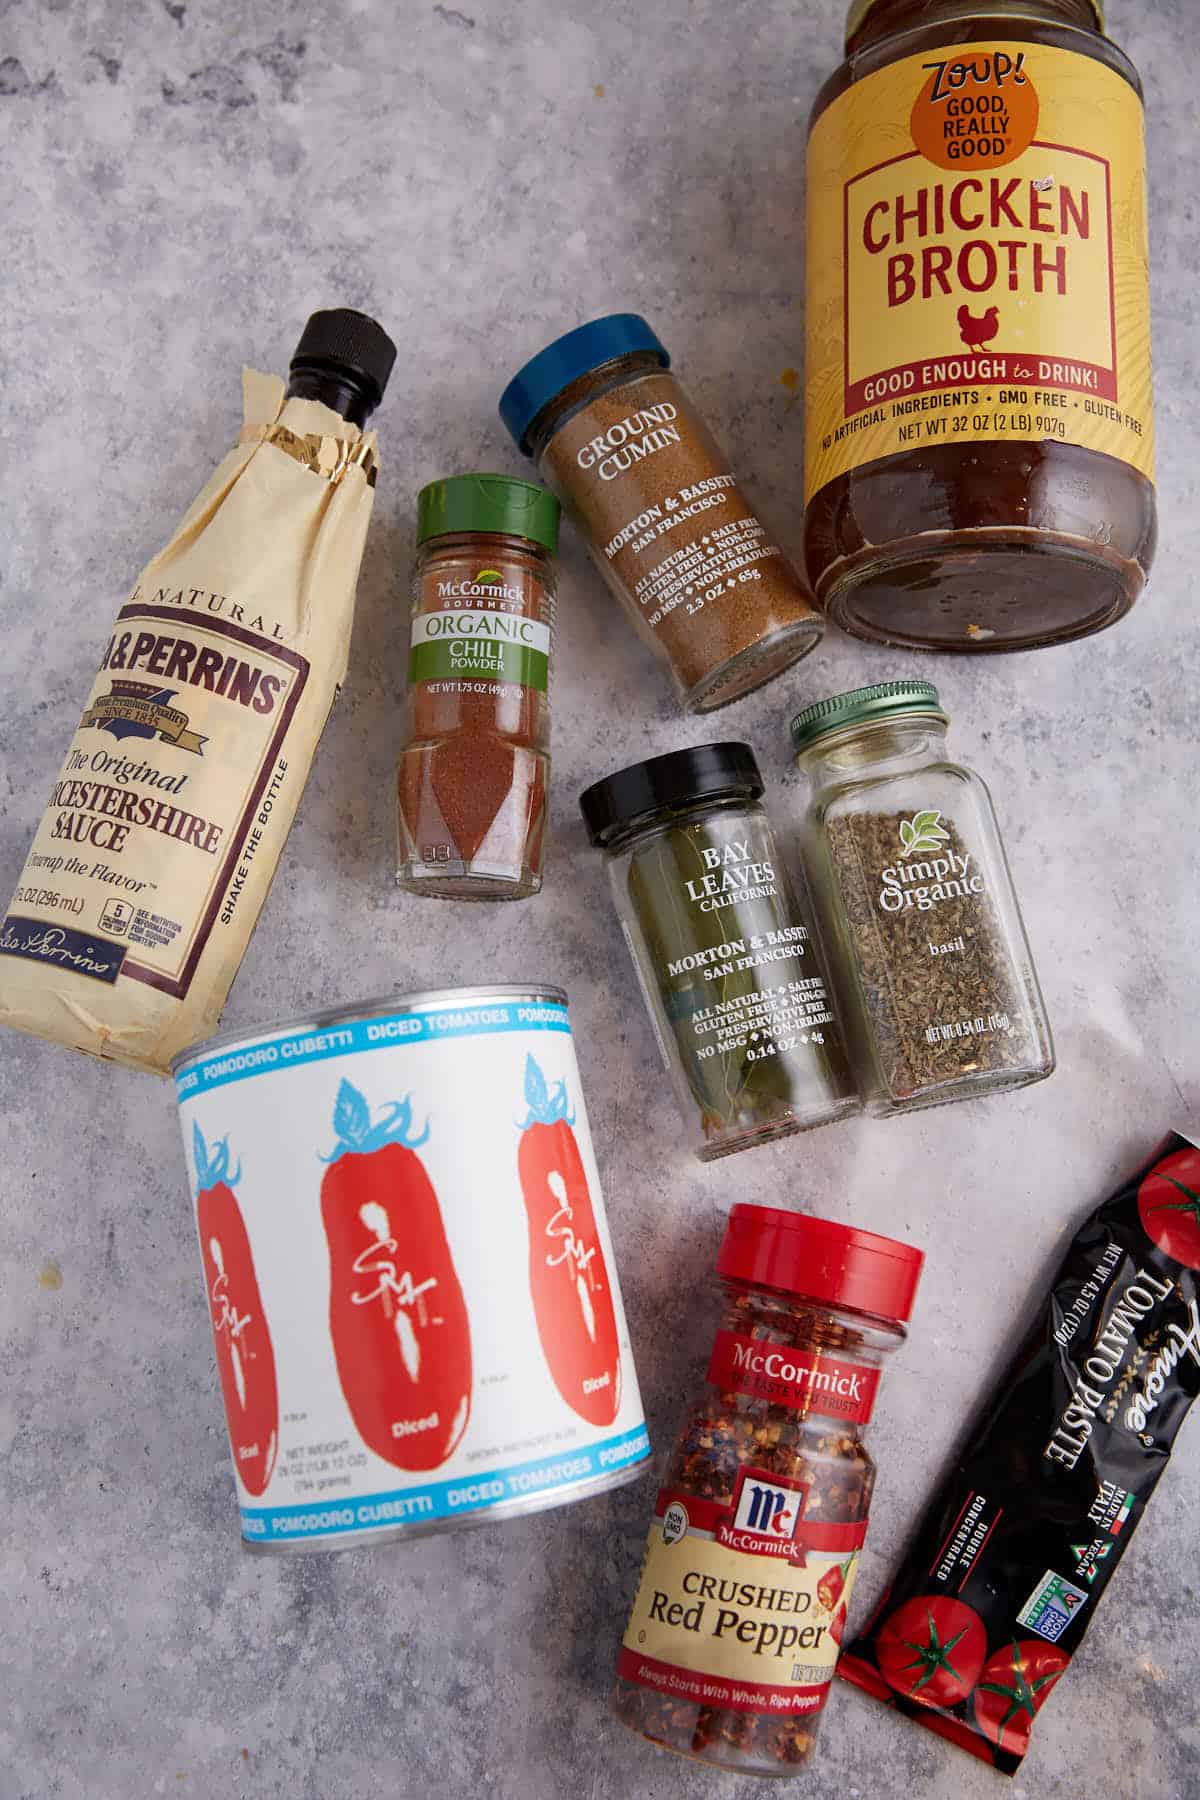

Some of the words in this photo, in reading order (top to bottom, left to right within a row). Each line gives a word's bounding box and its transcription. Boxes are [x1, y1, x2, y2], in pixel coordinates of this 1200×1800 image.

[946, 95, 1008, 117] GOOD,
[943, 116, 1010, 139] REALLY
[862, 176, 1090, 256] CHICKEN
[887, 239, 1067, 308] BROTH
[864, 369, 914, 401] GOOD
[922, 354, 1007, 385] ENOUGH
[1013, 363, 1034, 378] to
[1038, 361, 1098, 389] DRINK!
[577, 402, 677, 468] GROUND
[834, 409, 887, 443] ARTIFICIAL
[891, 391, 979, 418] INGREDIENTS
[999, 390, 1028, 405] GMO
[1034, 392, 1068, 408] FREE
[1084, 400, 1122, 422] GLUTEN
[1124, 418, 1144, 437] FREE
[898, 422, 921, 443] NET
[926, 418, 948, 436] WT
[952, 416, 968, 432] 32
[972, 415, 990, 432] OZ
[994, 415, 1008, 432] (2
[1011, 415, 1032, 432] LB)
[1036, 416, 1065, 437] 907g
[598, 425, 681, 481] CUMIN
[604, 503, 662, 560] MORTON
[664, 497, 681, 511] &
[631, 529, 656, 553] SAN
[656, 492, 727, 534] FRANCISCO
[635, 577, 652, 595] ALL
[648, 541, 702, 581] NATURAL
[711, 522, 738, 541] SALT
[437, 580, 526, 602] McCormick
[640, 570, 676, 604] GLUTEN
[677, 551, 706, 574] FREE
[656, 551, 736, 604] PRESERVATIVE
[686, 598, 704, 615] 2.3
[705, 583, 726, 601] OZ
[738, 568, 762, 584] 65g
[152, 588, 284, 640] NATURAL
[444, 599, 519, 612] GOURMET
[648, 612, 662, 626] NO
[660, 593, 684, 616] MSG
[425, 614, 534, 643] ORGANIC
[449, 640, 505, 660] CHILI
[450, 657, 505, 672] POWDER
[427, 683, 441, 694] NET
[441, 682, 456, 693] WT
[474, 683, 487, 693] OZ
[104, 706, 133, 717] SINCE
[66, 749, 88, 770] The
[91, 750, 189, 794] Original
[51, 811, 131, 853] SAUCE
[220, 866, 249, 925] SHAKE
[244, 827, 262, 861] THE
[259, 758, 288, 825] BOTTLE
[64, 857, 88, 875] the
[701, 840, 752, 869] BAY
[685, 862, 776, 901] LEAVES
[881, 850, 970, 897] Simply
[114, 904, 124, 917] 5
[700, 885, 777, 912] CALIFORNIA
[879, 874, 985, 912] Organic
[667, 939, 746, 976] MORTON
[750, 935, 765, 950] &
[703, 962, 734, 981] SAN
[738, 944, 805, 971] FRANCISCO
[927, 936, 966, 956] basil
[692, 1006, 715, 1023] ALL
[715, 989, 777, 1014] NATURAL
[694, 1010, 745, 1035] GLUTEN
[747, 1001, 777, 1018] FREE
[716, 1005, 806, 1040] PRESERVATIVE
[367, 1019, 423, 1041] DICED
[424, 1009, 510, 1031] TOMATOES
[925, 1025, 941, 1043] NET
[202, 1046, 278, 1080] POMODORO
[280, 1030, 352, 1059] CUBETTI
[696, 1045, 715, 1061] NO
[717, 1034, 747, 1054] MSG
[746, 1044, 777, 1062] 0.14
[777, 1037, 798, 1052] OZ
[1103, 1242, 1124, 1265] NET
[1081, 1279, 1101, 1301] 4.5
[1095, 1263, 1112, 1284] WT
[1072, 1299, 1091, 1317] OZ
[1087, 1268, 1174, 1384] TOMATO
[1053, 1311, 1081, 1348] (127g)
[732, 1342, 862, 1401] McCormick
[392, 1412, 440, 1438] Diced
[1046, 1376, 1105, 1471] PASTE
[447, 1480, 504, 1507] DICED
[507, 1457, 593, 1491] TOMATOES
[272, 1508, 354, 1533] POMODORO
[357, 1495, 432, 1522] CUBETTI
[1087, 1479, 1117, 1526] ITALY
[1107, 1487, 1127, 1518] MADE
[720, 1525, 800, 1558] McCormick
[936, 1494, 987, 1582] CONCENTRATED
[959, 1522, 989, 1569] DOUBLE
[1075, 1539, 1104, 1577] VEGAN
[682, 1571, 811, 1614] CRUSHED
[1026, 1578, 1061, 1626] VERIFIED
[648, 1590, 705, 1633] Red
[712, 1608, 827, 1659] Pepper
[1040, 1610, 1059, 1634] GMO
[1047, 1615, 1067, 1638] NON
[668, 1675, 702, 1695] Starts
[703, 1683, 729, 1700] With
[769, 1694, 791, 1709] Ripe
